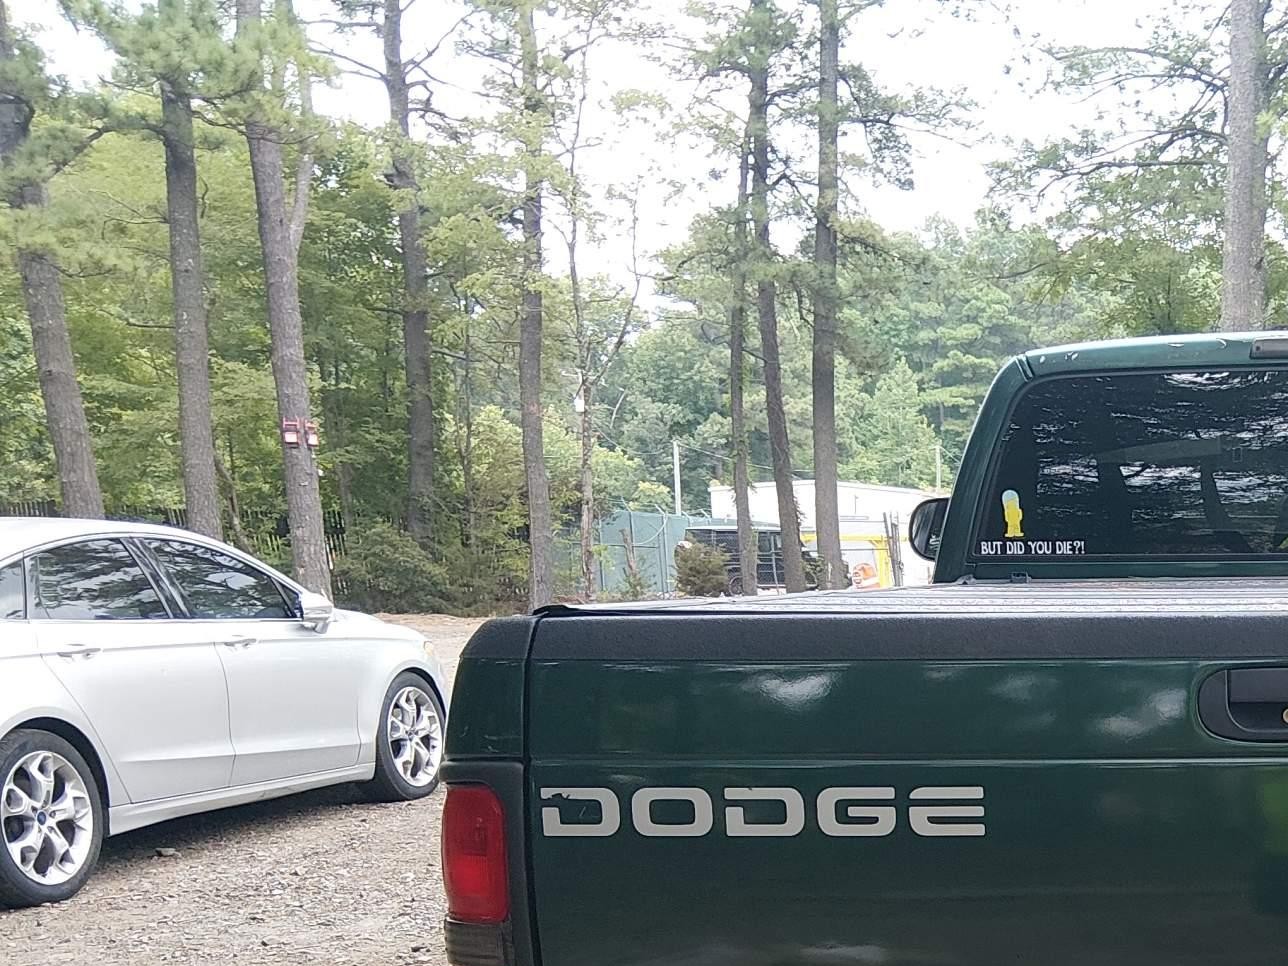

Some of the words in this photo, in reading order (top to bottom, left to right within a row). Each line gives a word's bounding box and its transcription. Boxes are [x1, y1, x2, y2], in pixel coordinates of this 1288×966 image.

[980, 541, 1003, 555] BUT
[1006, 541, 1025, 555] DID
[1028, 541, 1052, 555] YOU
[1056, 540, 1085, 555] DIE?!
[540, 786, 986, 837] DODGE
